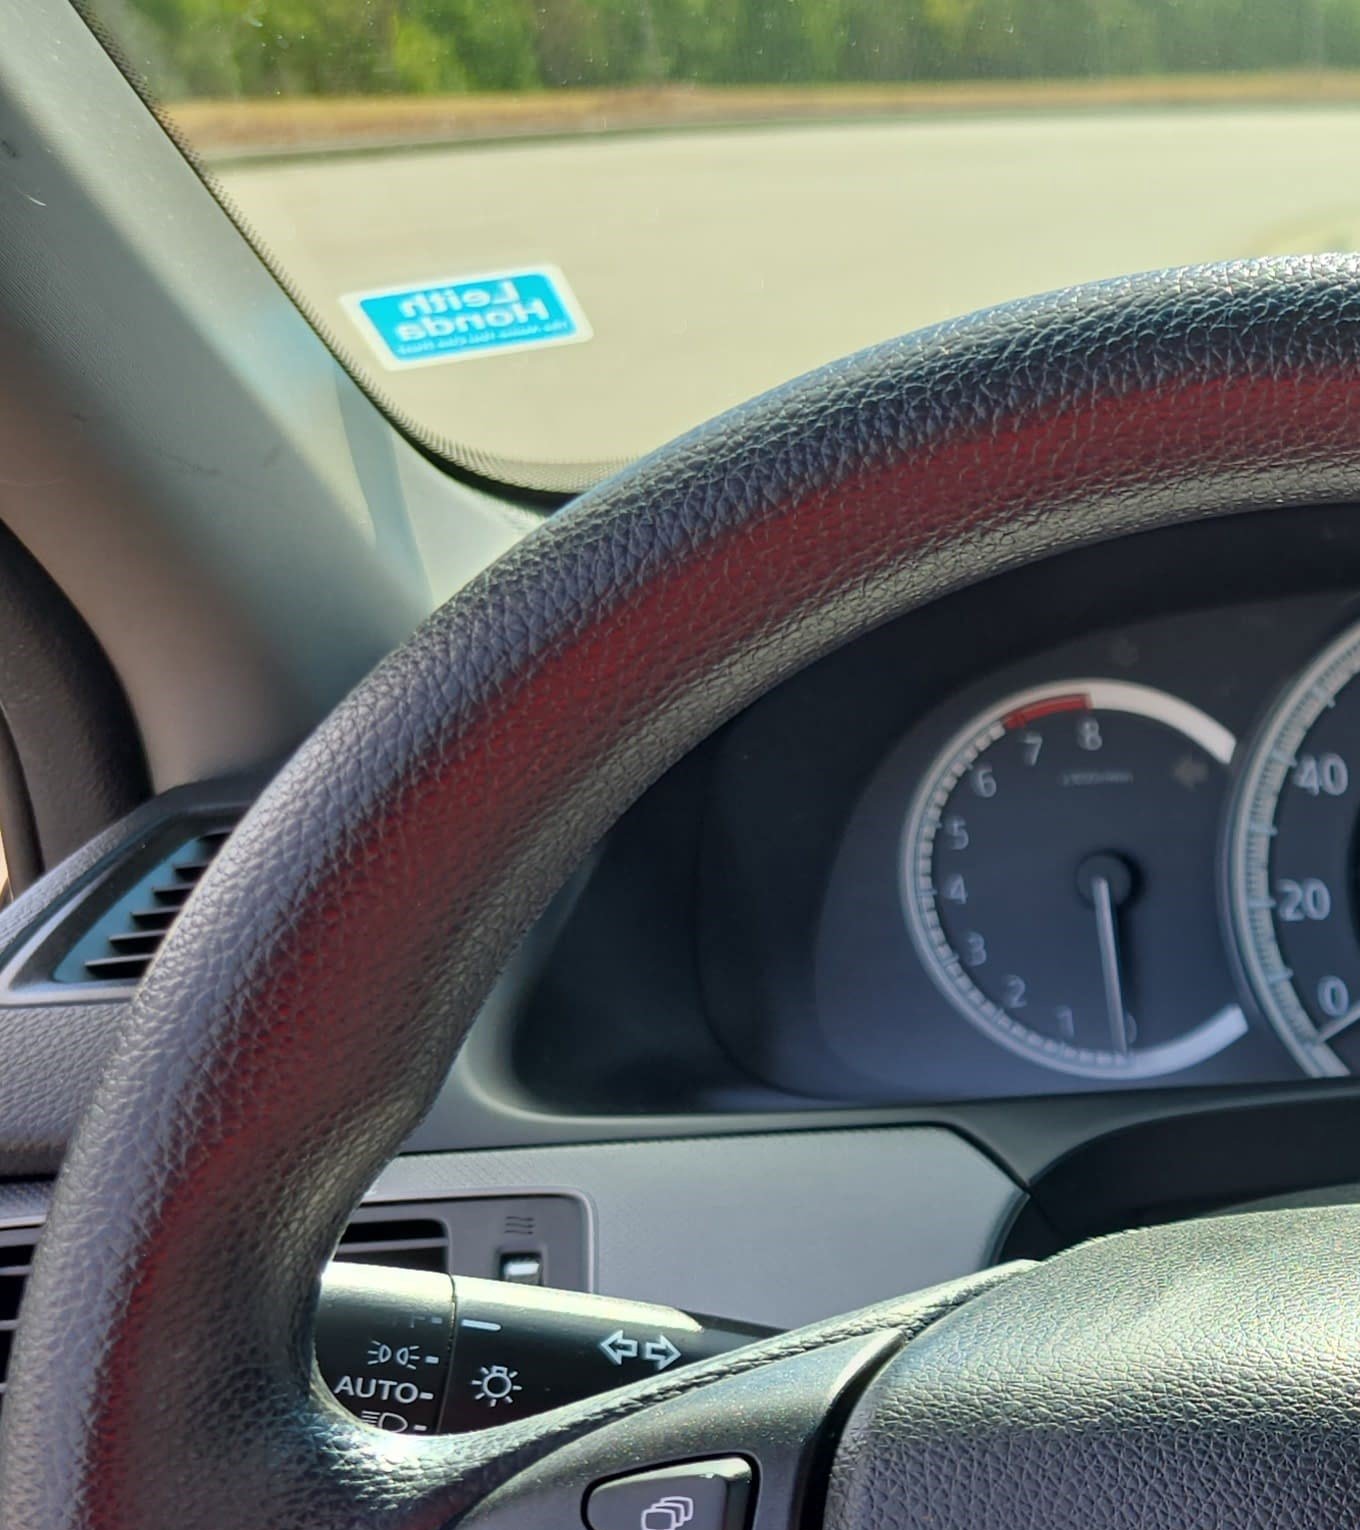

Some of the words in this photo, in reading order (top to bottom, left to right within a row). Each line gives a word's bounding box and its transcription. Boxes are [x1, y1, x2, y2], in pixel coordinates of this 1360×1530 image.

[1021, 733, 1043, 768] 7
[1080, 720, 1102, 752] 8
[976, 767, 997, 799] 6
[1294, 753, 1349, 797] 40
[949, 816, 970, 851] 5
[949, 874, 968, 905] 4
[1276, 877, 1331, 922] 20
[968, 932, 987, 967] 3
[1009, 975, 1027, 1008] 2
[1321, 975, 1350, 1018] 0
[1058, 1007, 1075, 1037] 1
[333, 1375, 419, 1400] AUTO
